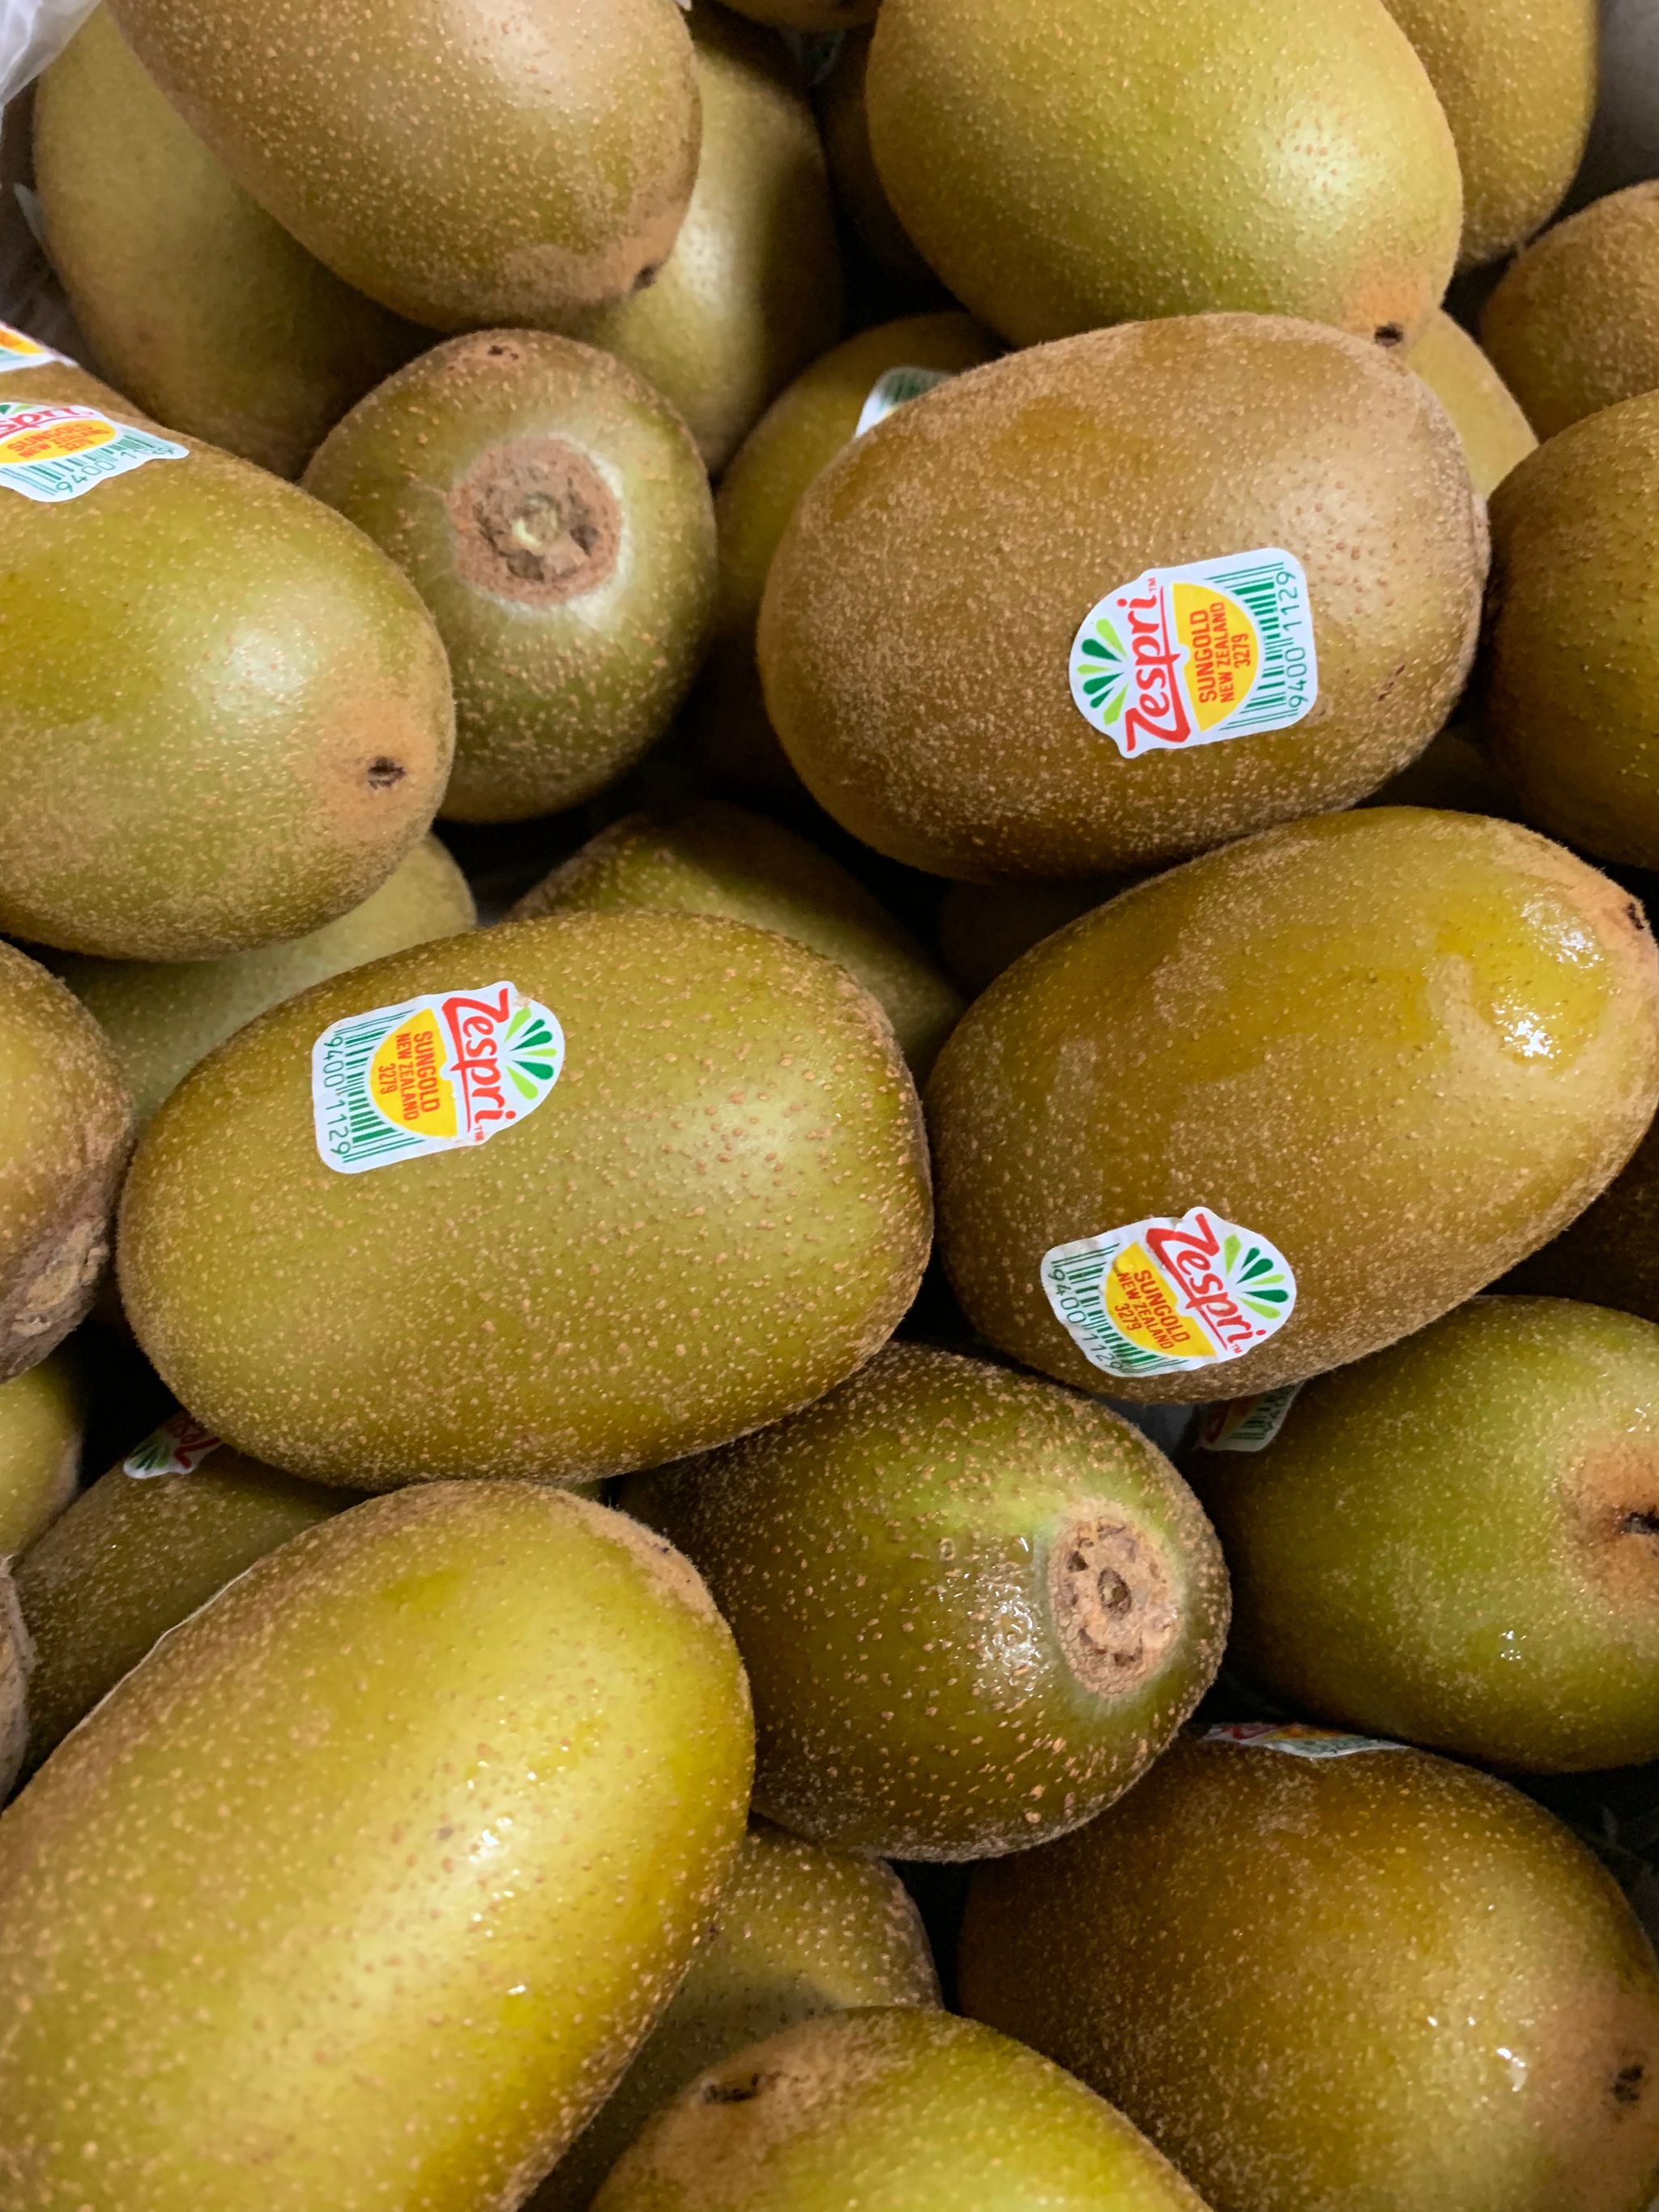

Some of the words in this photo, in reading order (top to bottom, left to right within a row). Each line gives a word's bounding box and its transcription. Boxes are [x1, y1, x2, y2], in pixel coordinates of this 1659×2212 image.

[7, 424, 92, 452] SUNGOLD
[56, 460, 115, 492] 9400
[1276, 570, 1302, 632] 1129
[1189, 609, 1218, 704] SUNGOLD
[1209, 602, 1231, 669] ZEALAND
[1230, 633, 1251, 669] 3279
[1116, 586, 1191, 752] Zespri
[1218, 671, 1235, 703] NEW
[1284, 646, 1308, 709] 9400
[322, 1036, 346, 1089] 9400
[396, 1033, 412, 1059] NEW
[414, 1030, 441, 1113] SUNGOLD
[441, 988, 516, 1133] Zespri
[378, 1063, 398, 1095] 3279
[398, 1062, 420, 1122] ZEALAND
[325, 1100, 352, 1155] 1129
[1047, 1268, 1087, 1324] 9400
[1117, 1272, 1139, 1301] NEW
[1132, 1301, 1175, 1350] ZEALAND
[1134, 1269, 1191, 1344] SUNGOLD
[1145, 1213, 1267, 1351] Zespri
[1114, 1303, 1142, 1332] 3279
